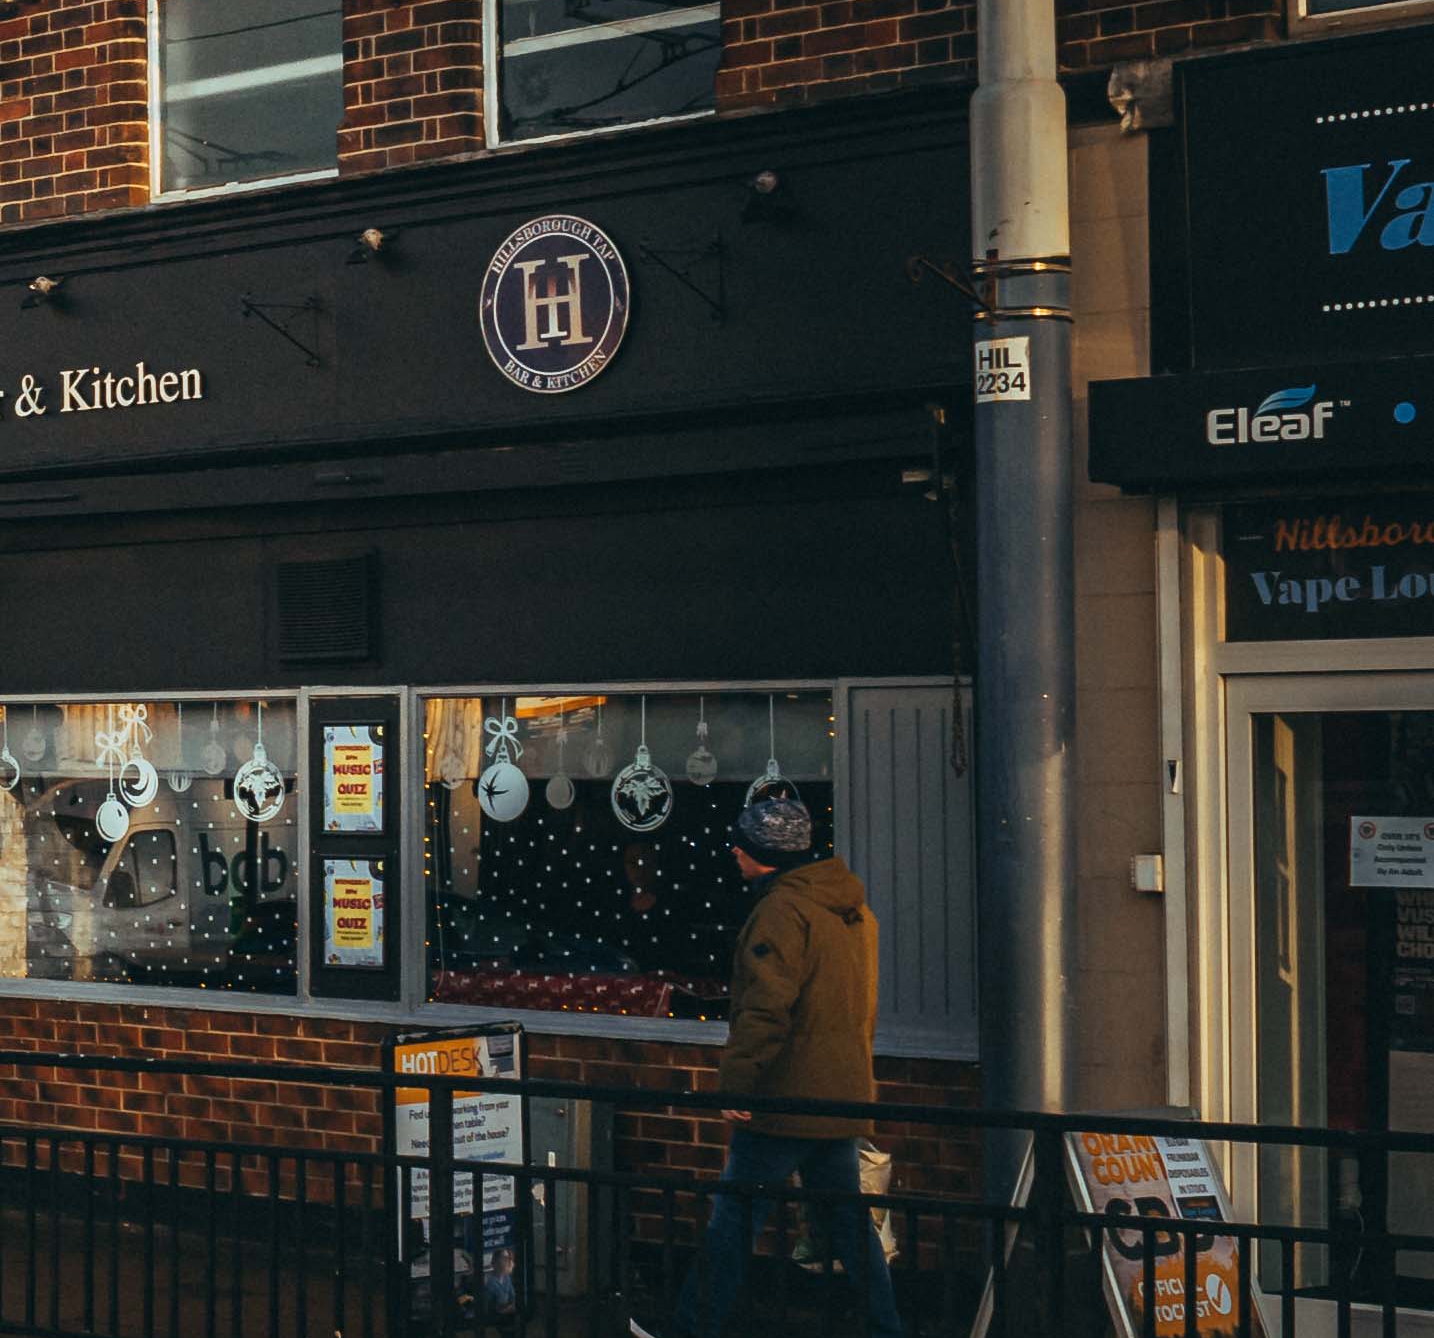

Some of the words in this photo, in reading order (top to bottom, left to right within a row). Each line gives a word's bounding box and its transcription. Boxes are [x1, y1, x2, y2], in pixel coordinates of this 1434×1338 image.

[491, 219, 594, 275] HILLSBOROUGH
[592, 231, 615, 261] TAP
[503, 359, 529, 386] BAR
[531, 374, 543, 388] &
[546, 348, 608, 389] KITCHEN
[978, 347, 1022, 370] HIL
[14, 374, 46, 418] &
[59, 361, 203, 413] Kitchen
[978, 371, 1027, 395] 2234
[1206, 401, 1335, 446] Eleaf
[1251, 569, 1361, 613] Vape
[333, 764, 371, 776] MUSIC
[337, 783, 367, 795] QUIZ
[332, 898, 371, 910] MUSIC
[337, 917, 367, 929] QUIZ
[409, 1109, 422, 1121] Fed
[479, 1101, 495, 1112] from
[496, 1100, 510, 1111] your
[465, 1116, 486, 1129] table?
[1186, 1183, 1209, 1194] STOCK
